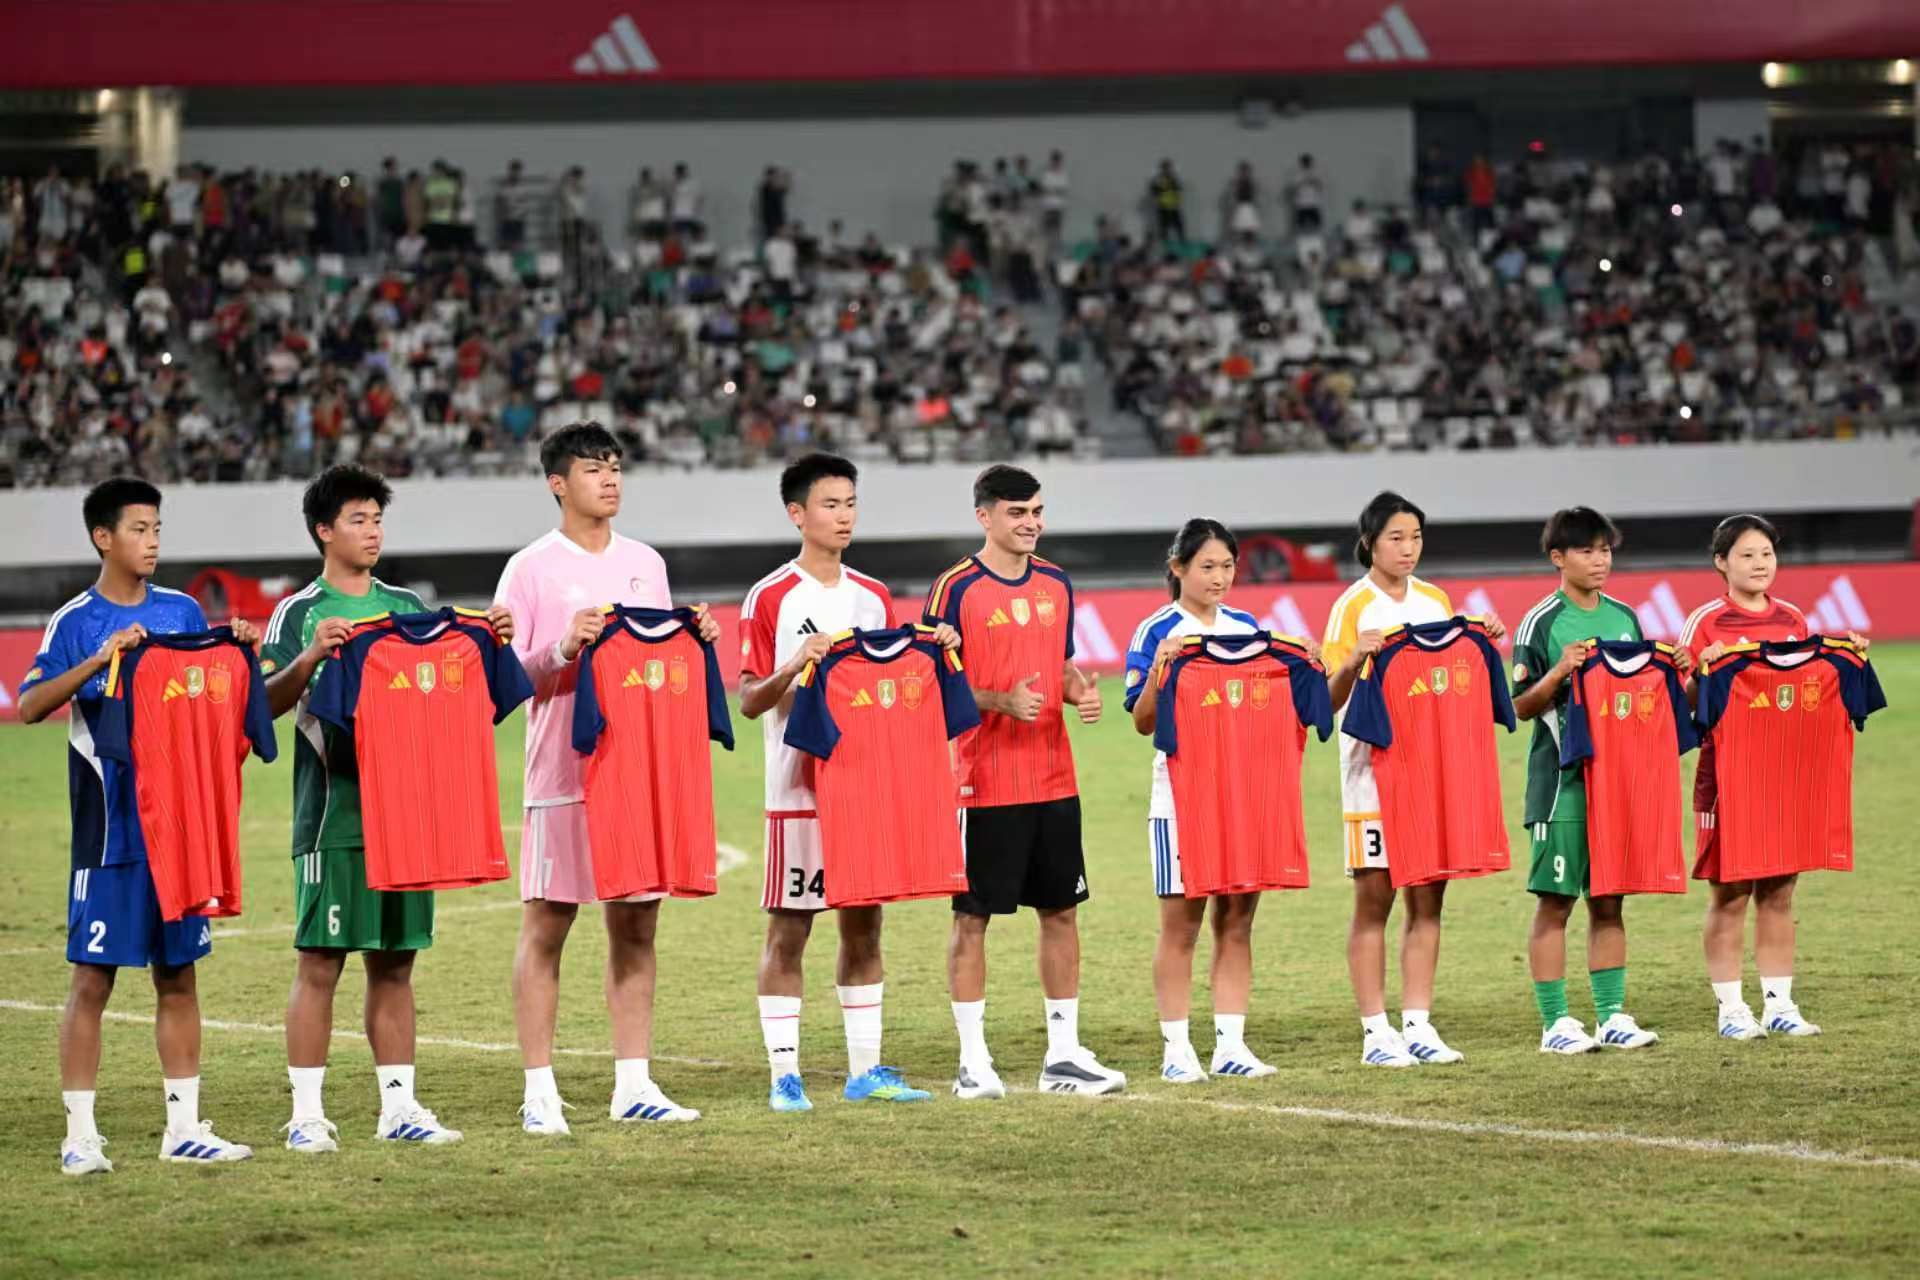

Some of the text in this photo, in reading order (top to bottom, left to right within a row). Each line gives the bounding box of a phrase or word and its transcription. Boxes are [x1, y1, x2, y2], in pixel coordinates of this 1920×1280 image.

[1366, 829, 1381, 857] 3
[789, 867, 825, 898] 34
[1553, 855, 1566, 883] 9
[328, 904, 341, 936] 6
[87, 920, 106, 953] 2
